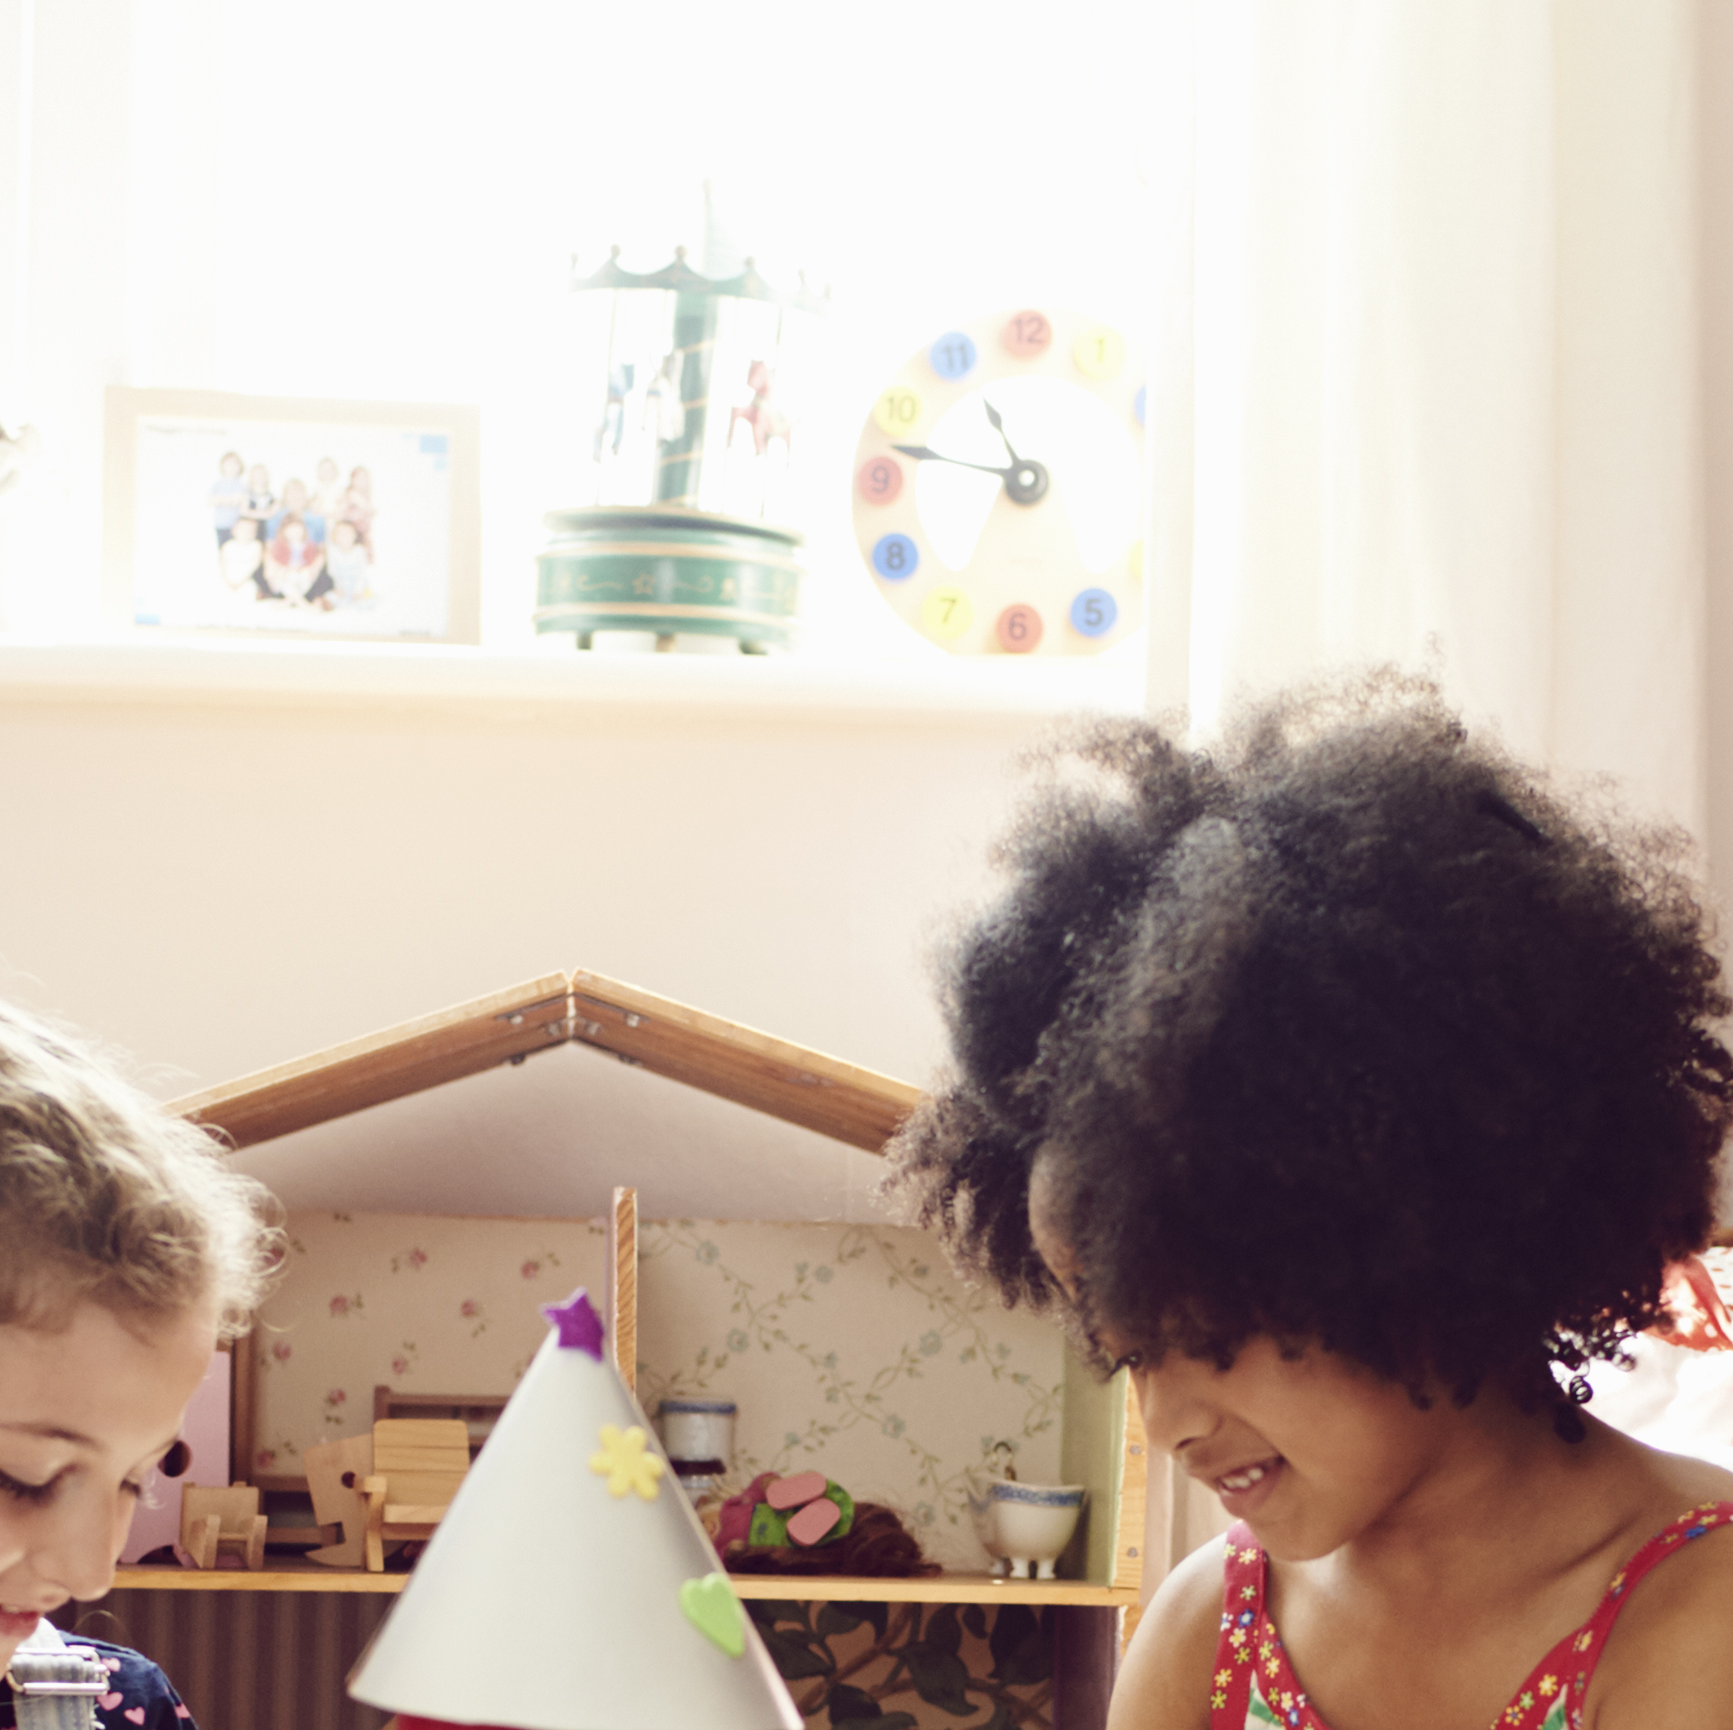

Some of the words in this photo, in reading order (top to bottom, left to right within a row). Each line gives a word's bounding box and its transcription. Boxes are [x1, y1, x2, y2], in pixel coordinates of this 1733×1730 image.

[1013, 317, 1044, 345] 12
[941, 342, 969, 372] 11
[1093, 338, 1106, 364] 1
[886, 394, 916, 423] 10
[871, 465, 890, 495] 9
[885, 541, 907, 571] 8
[938, 597, 958, 624] 7
[1083, 598, 1104, 628] 5
[1007, 611, 1028, 641] 6
